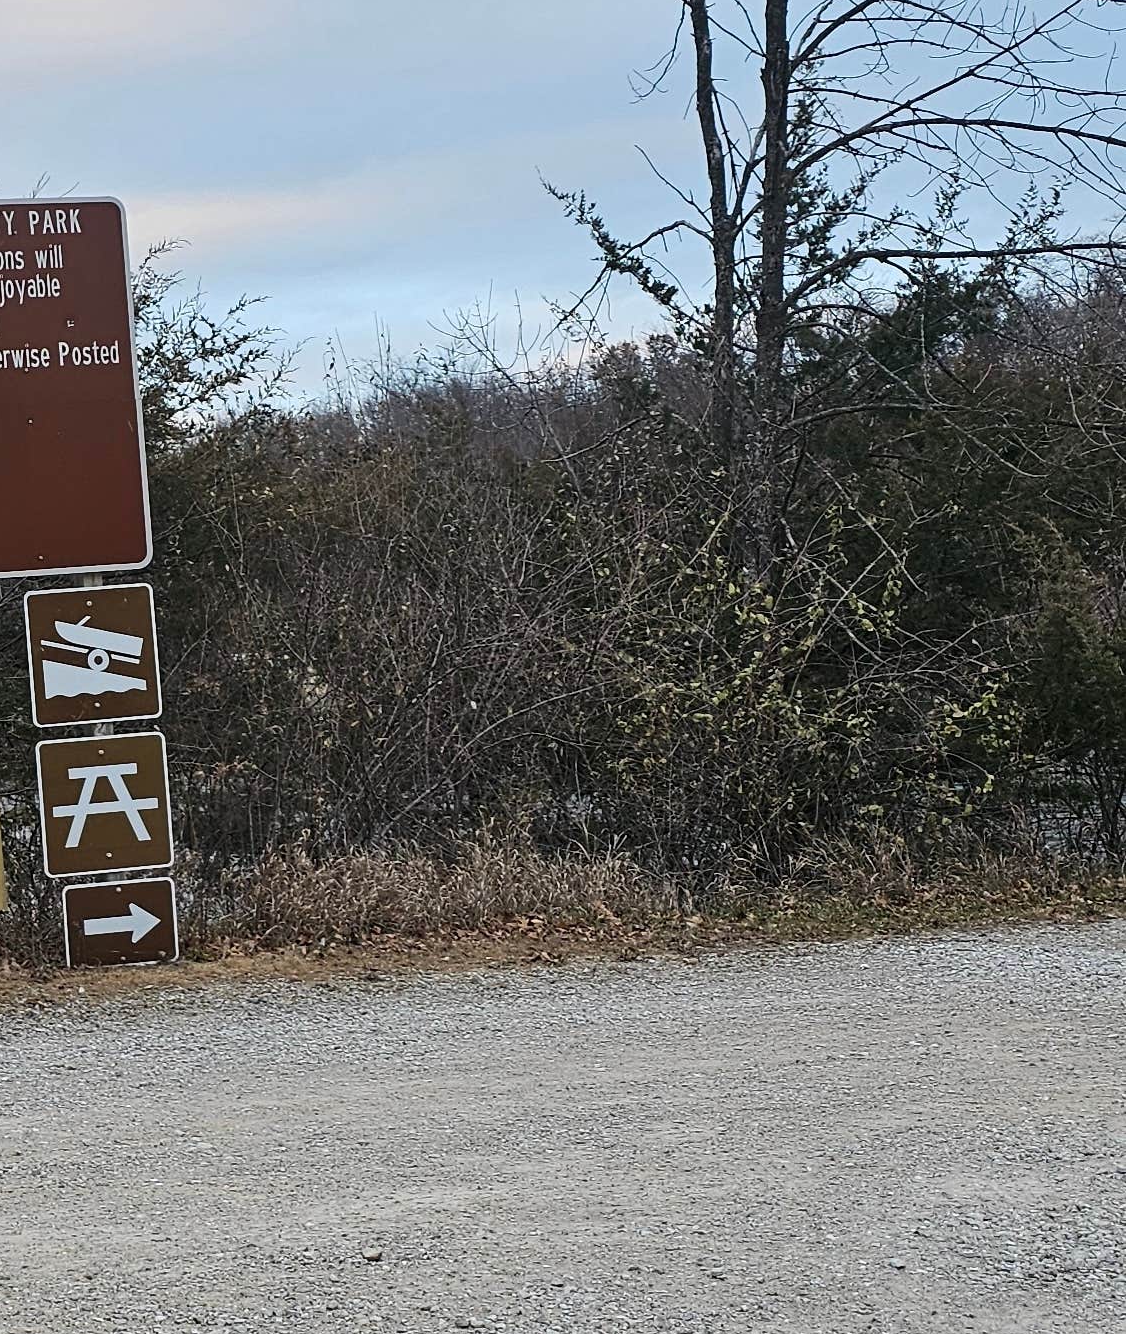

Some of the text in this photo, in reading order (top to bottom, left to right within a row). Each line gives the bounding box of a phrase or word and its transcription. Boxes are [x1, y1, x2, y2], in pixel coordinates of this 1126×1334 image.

[29, 208, 82, 235] PARK
[35, 244, 64, 269] will
[58, 340, 120, 366] Posted
